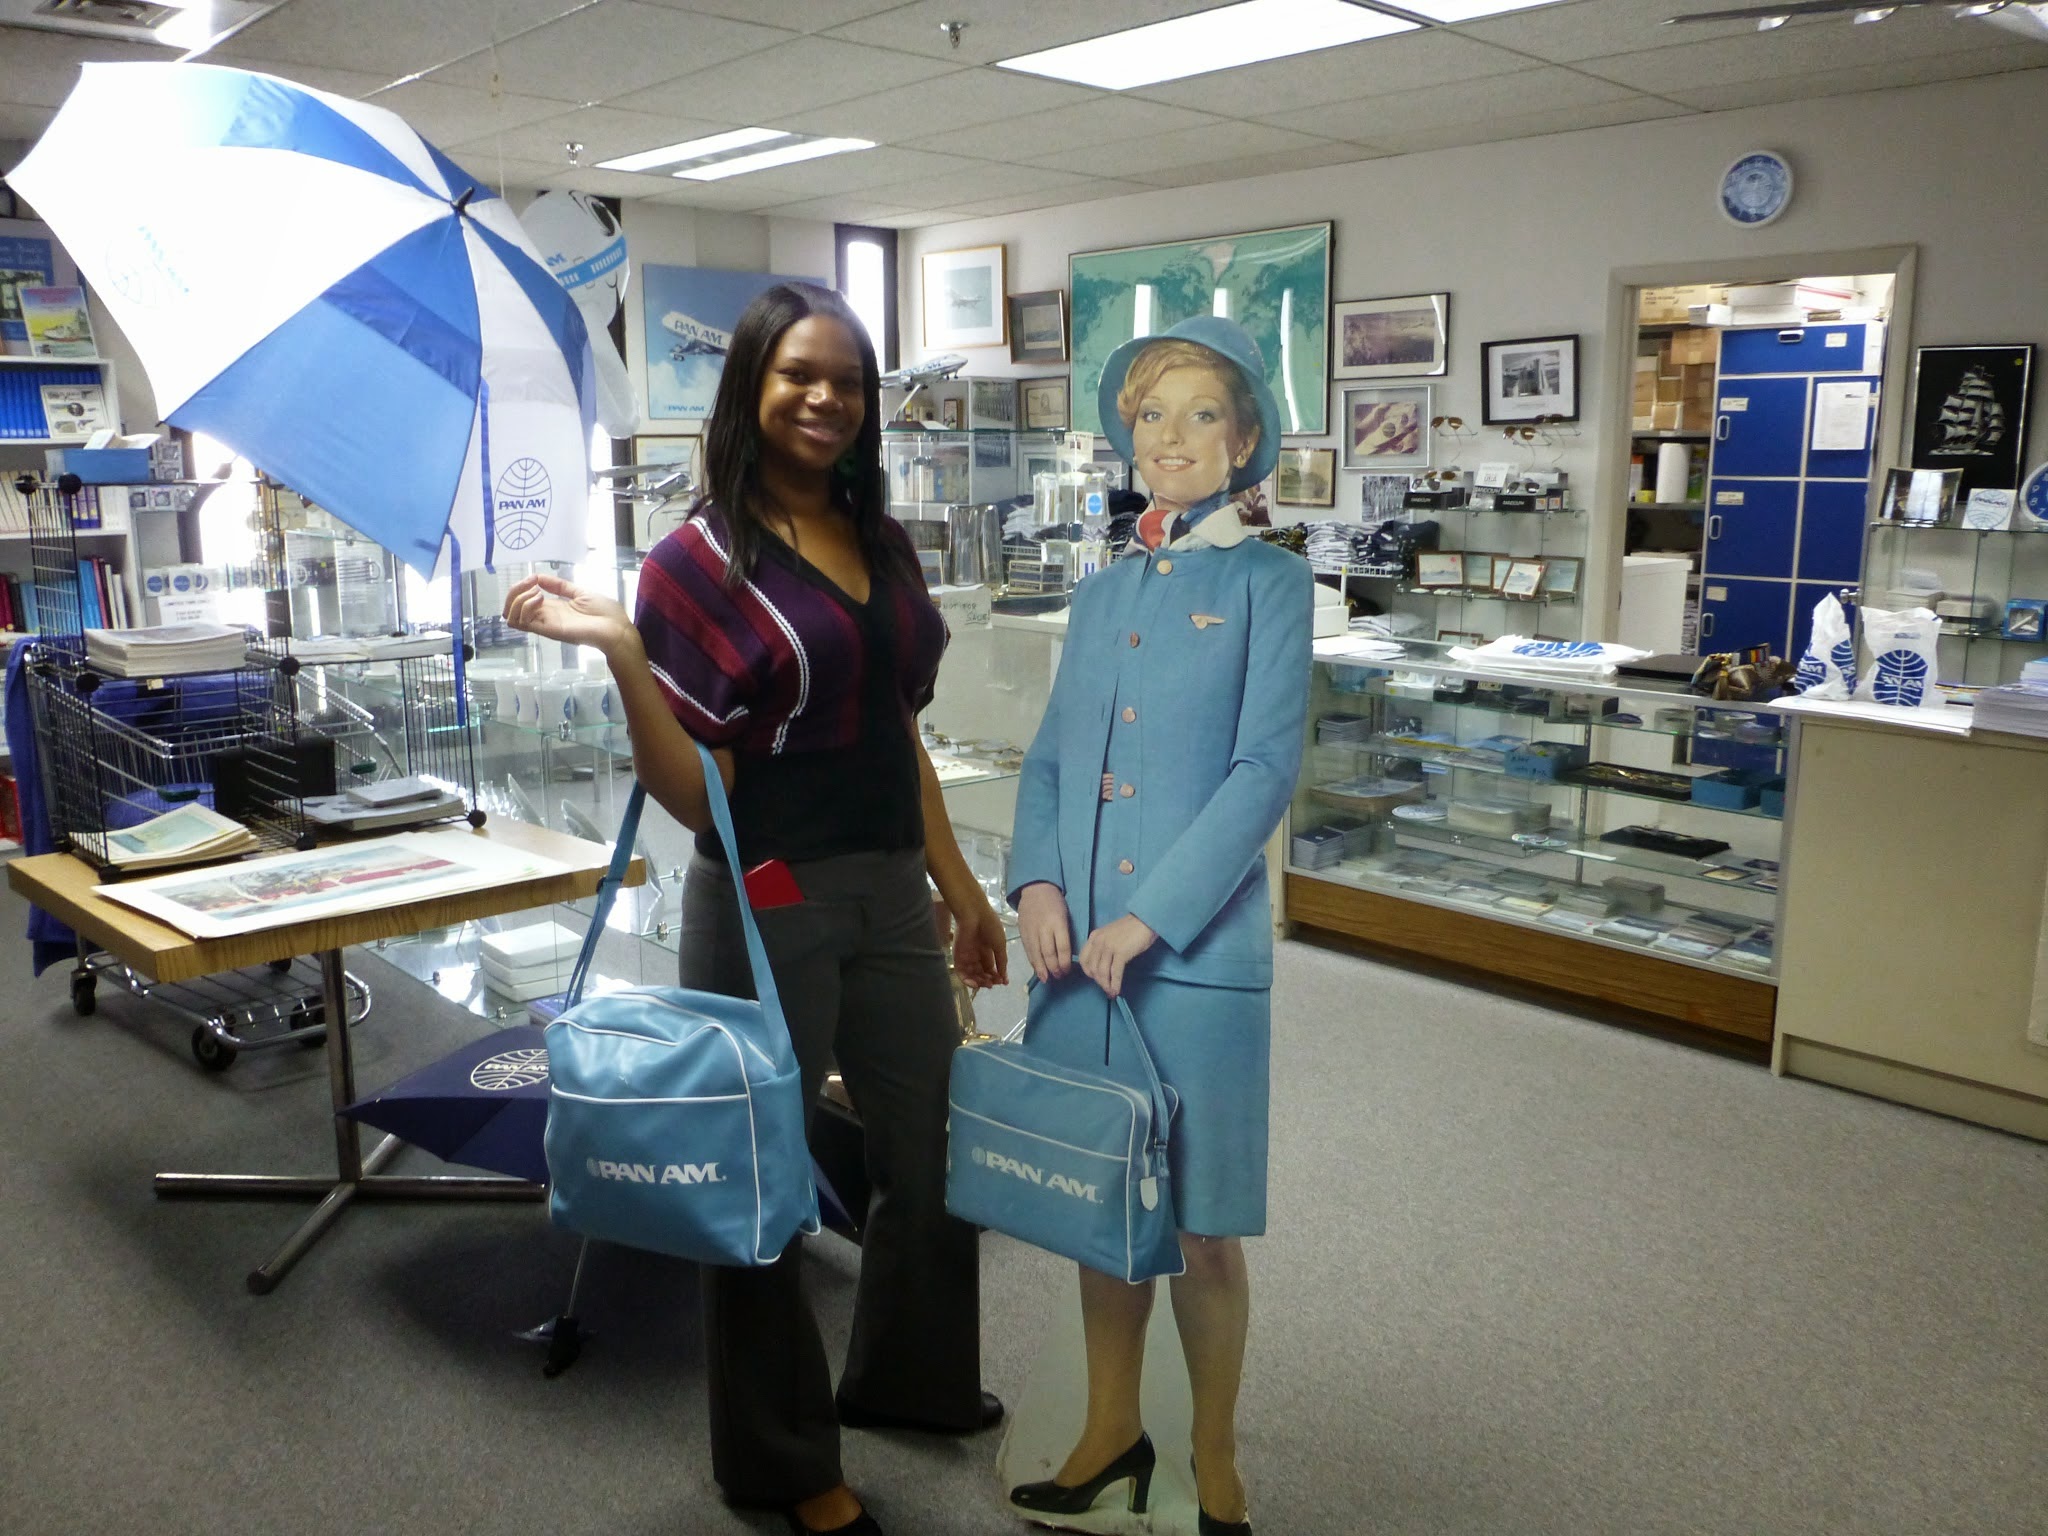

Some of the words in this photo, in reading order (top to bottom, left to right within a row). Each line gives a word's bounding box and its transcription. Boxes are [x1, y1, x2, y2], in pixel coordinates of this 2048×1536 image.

[674, 320, 699, 337] PAN
[701, 330, 722, 345] AM
[498, 500, 525, 510] PAN
[525, 498, 547, 509] AM
[484, 1063, 521, 1071] PAN
[599, 1160, 656, 1184] PAN
[985, 1150, 1044, 1184] PAN
